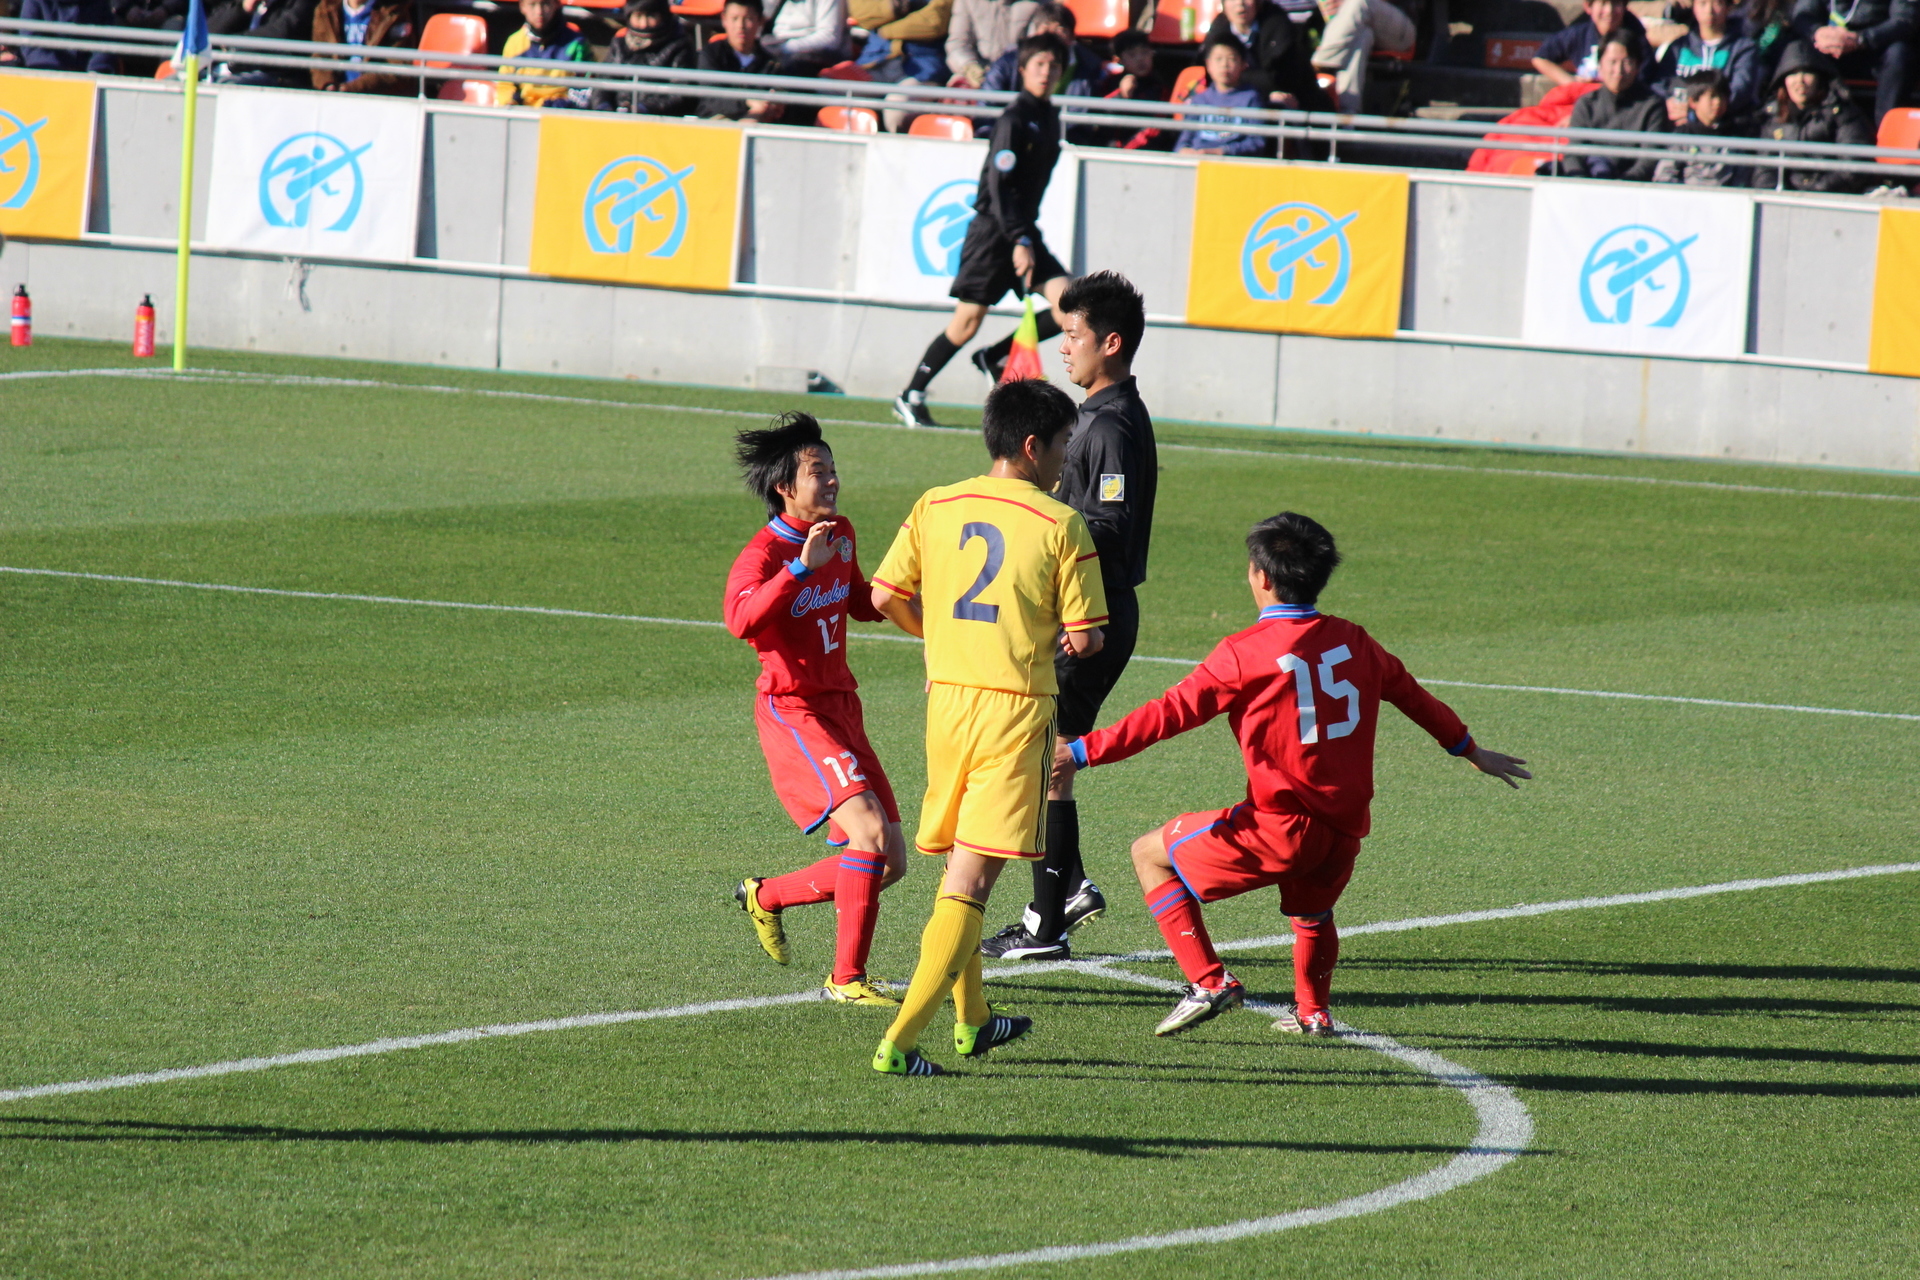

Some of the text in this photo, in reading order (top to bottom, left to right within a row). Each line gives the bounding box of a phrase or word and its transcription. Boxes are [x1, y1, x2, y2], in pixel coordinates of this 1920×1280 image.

[953, 522, 1005, 624] 2
[1276, 644, 1360, 744] 15
[822, 751, 867, 788] 12
